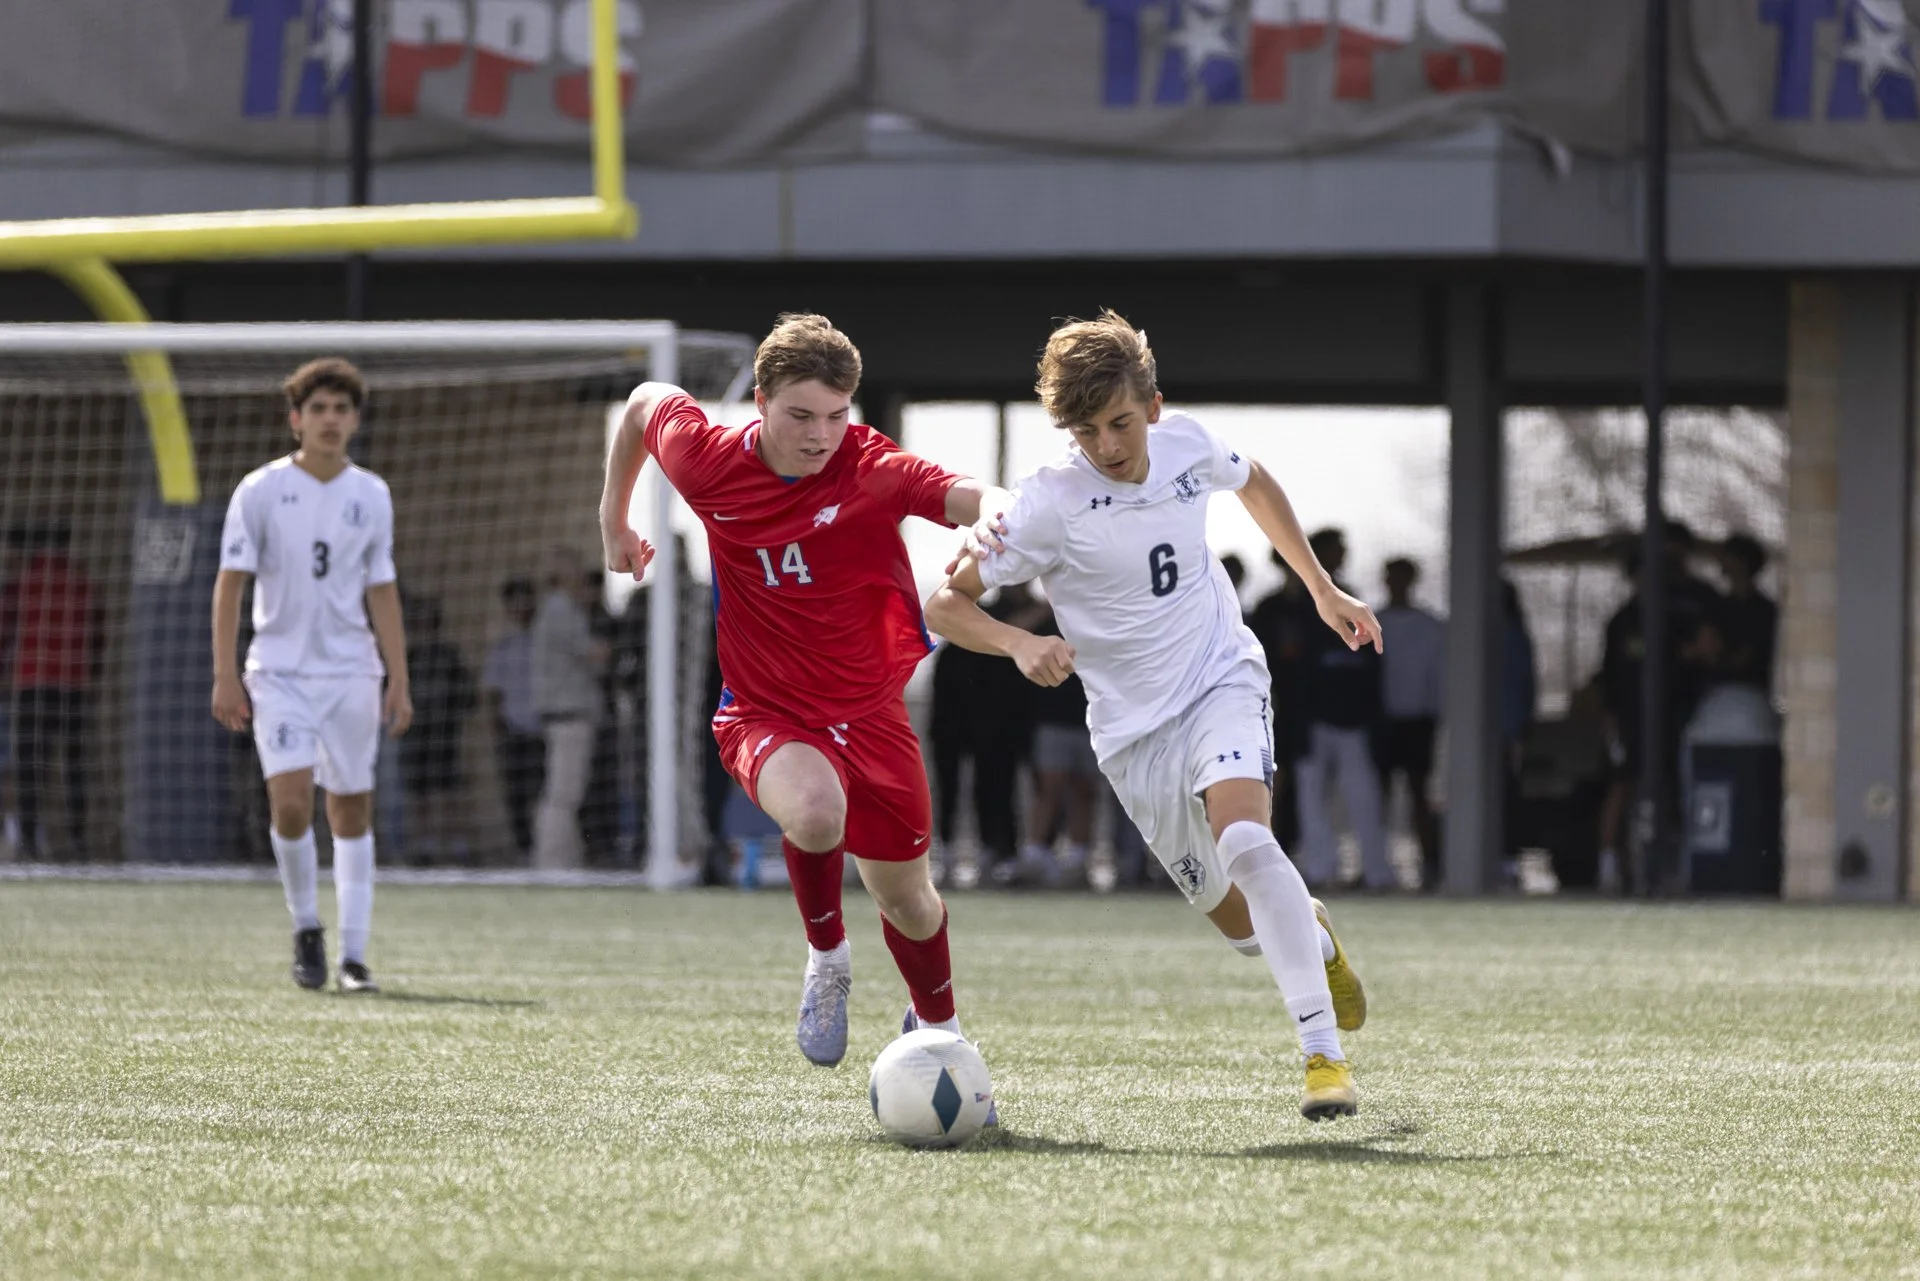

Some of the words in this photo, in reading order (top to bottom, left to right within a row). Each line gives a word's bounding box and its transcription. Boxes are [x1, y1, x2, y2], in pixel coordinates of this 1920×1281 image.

[230, 0, 643, 119] TAPPS
[1086, 0, 1506, 107] TAPPS
[312, 540, 329, 579] 3
[756, 542, 813, 587] 14
[1149, 542, 1178, 598] 6
